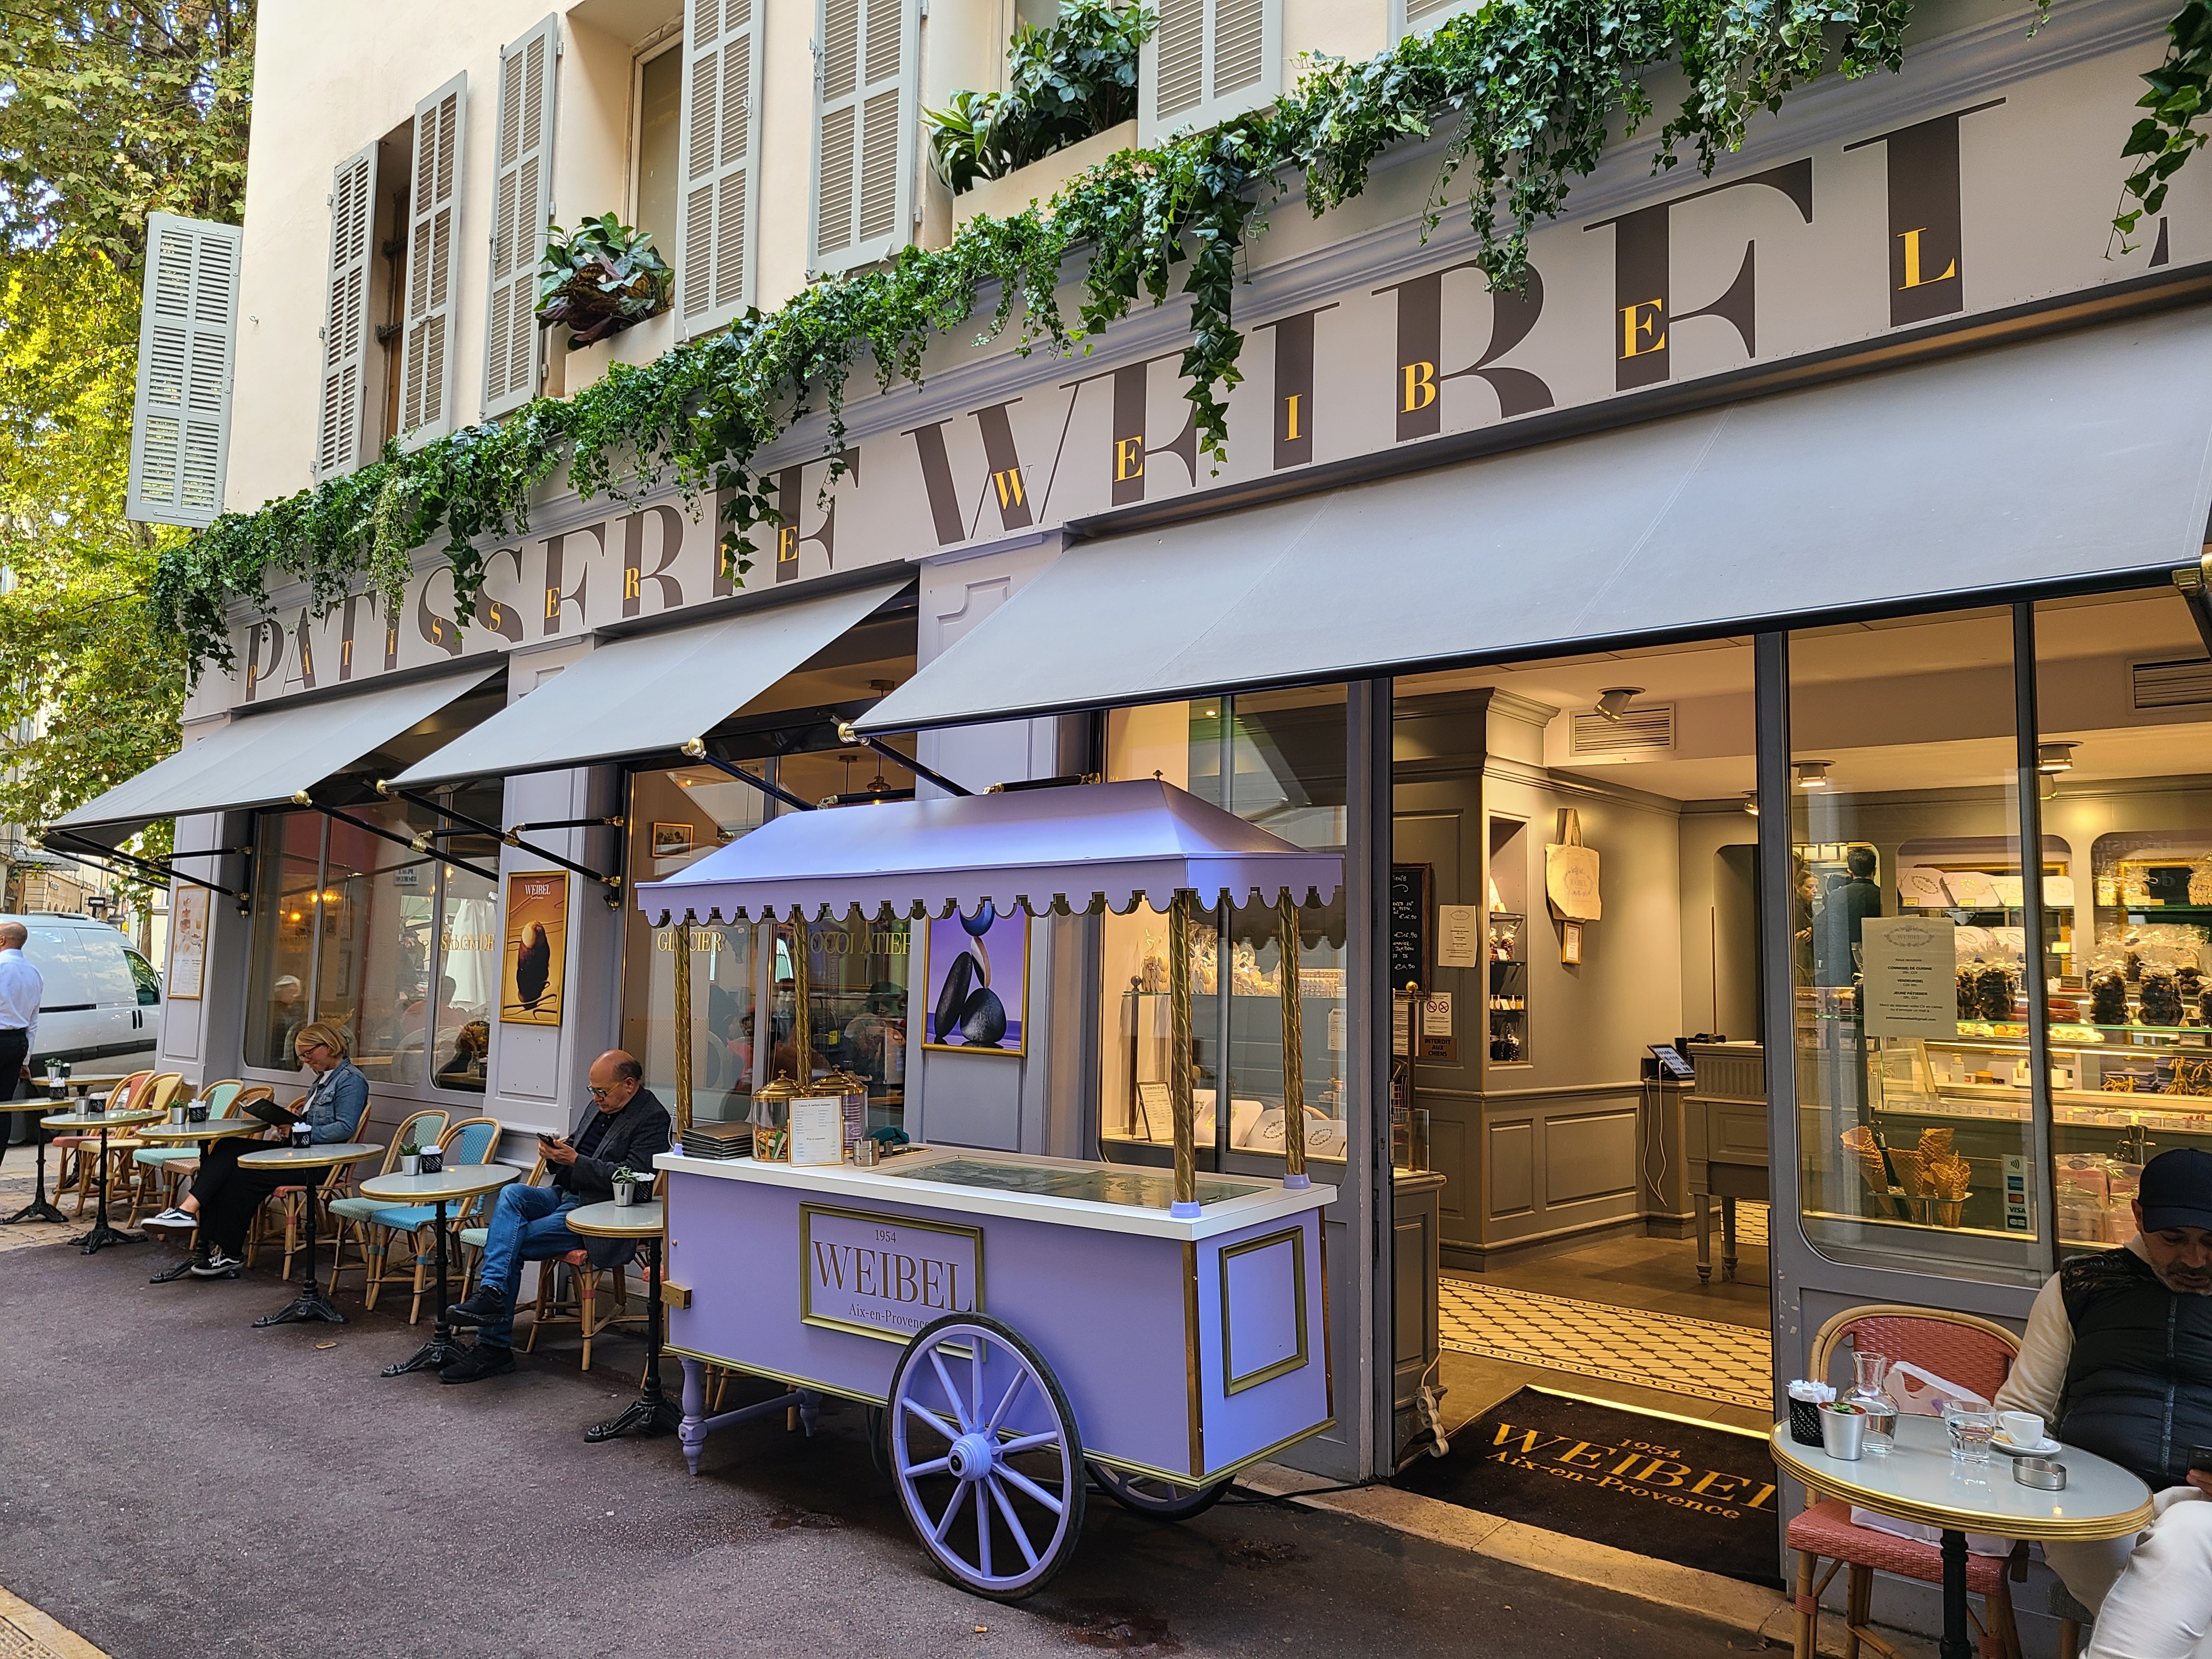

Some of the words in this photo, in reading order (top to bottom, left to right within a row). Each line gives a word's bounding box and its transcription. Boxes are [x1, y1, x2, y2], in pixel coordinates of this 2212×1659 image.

[900, 98, 2170, 546] WEIBEL
[991, 227, 1956, 511] WEIBEL
[524, 884, 551, 895] WEIBEL
[657, 932, 722, 952] GLCIER
[875, 1229, 896, 1244] 1954
[812, 1240, 973, 1313] WEIBEL
[1618, 1438, 1681, 1459] 1954
[1485, 1451, 1741, 1520] Aix-en-Provence
